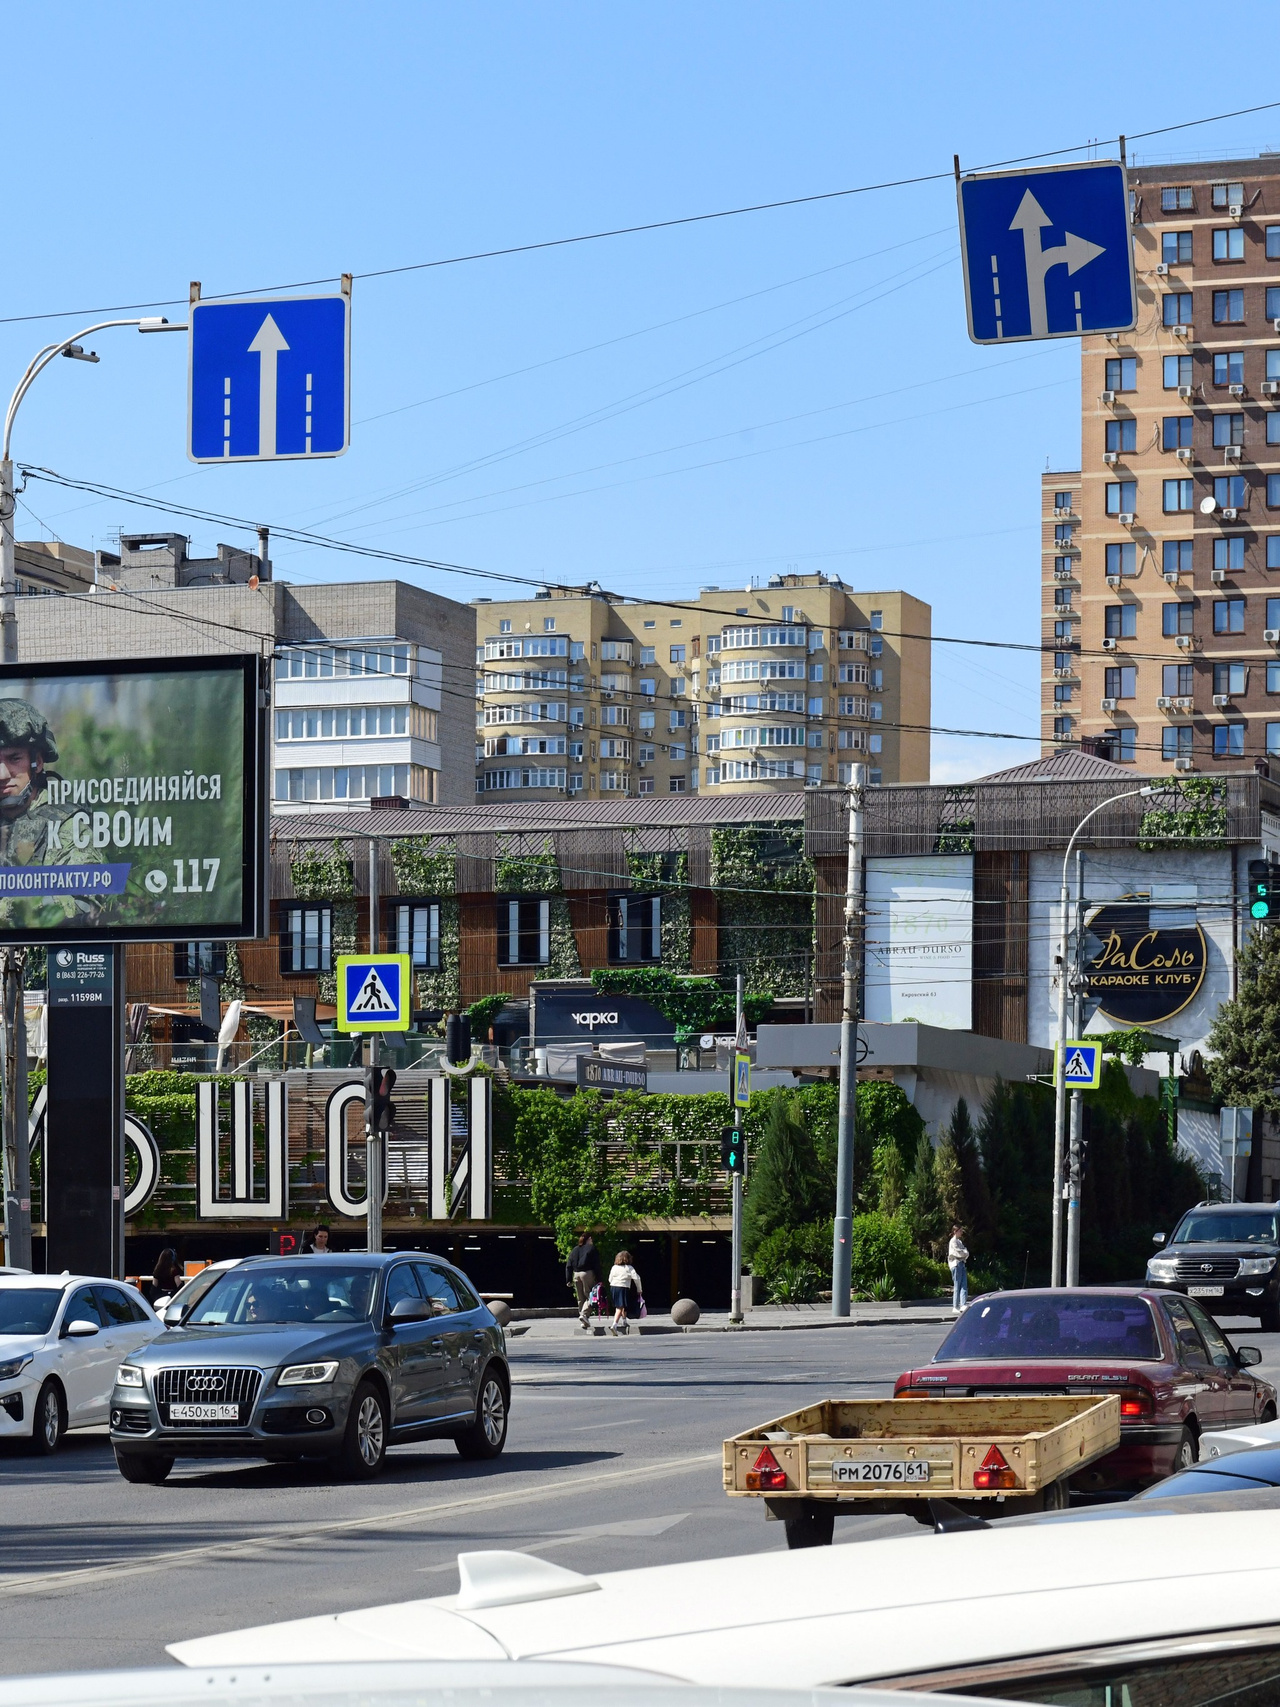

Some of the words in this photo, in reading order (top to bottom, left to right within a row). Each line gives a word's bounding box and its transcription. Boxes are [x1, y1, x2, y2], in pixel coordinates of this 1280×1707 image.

[47, 770, 222, 806] ПРИСОЕДИНЯЙСЯ
[172, 858, 221, 893] 117
[76, 953, 105, 963] Russ
[1090, 975, 1150, 986] КАРАОКЕ
[1155, 974, 1191, 985] КЛУБ
[71, 993, 102, 1002] 11598М
[572, 1012, 618, 1030] чарка
[173, 1406, 217, 1417] Е450ХВ
[219, 1405, 237, 1415] 161
[906, 1463, 923, 1475] 61
